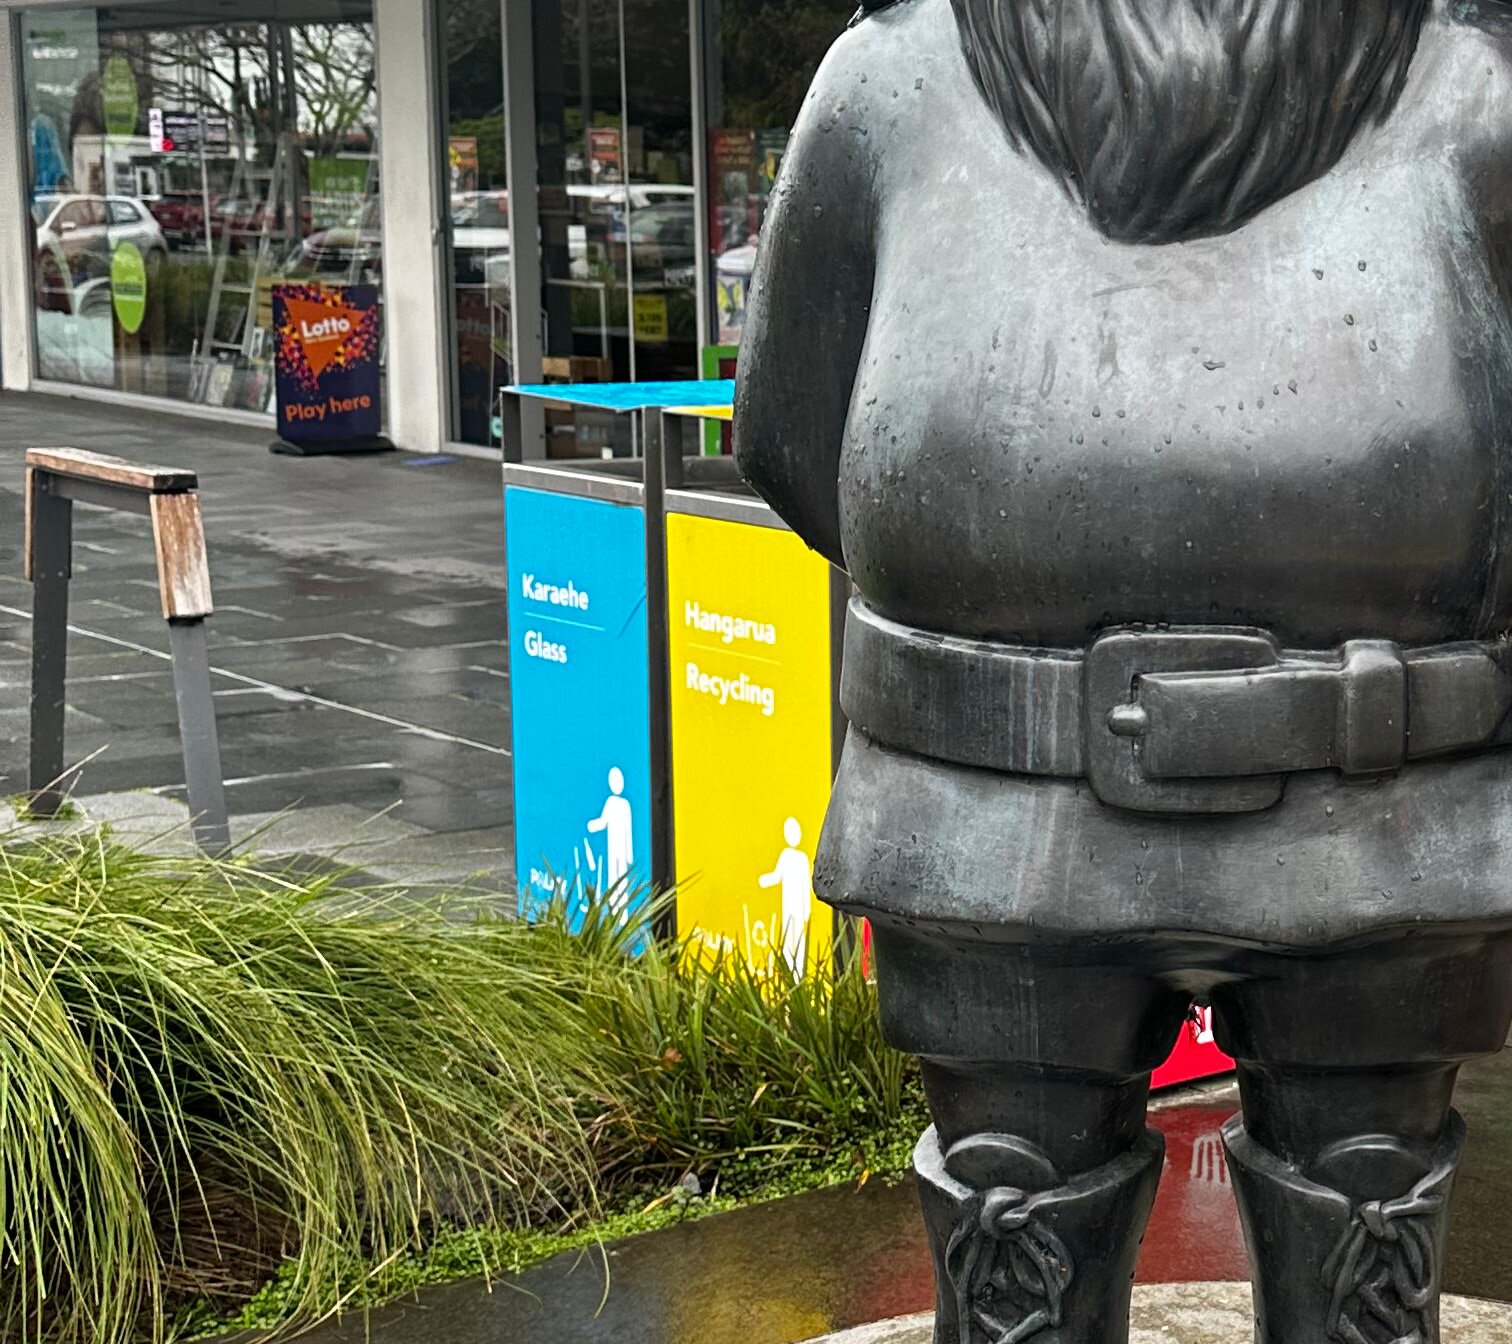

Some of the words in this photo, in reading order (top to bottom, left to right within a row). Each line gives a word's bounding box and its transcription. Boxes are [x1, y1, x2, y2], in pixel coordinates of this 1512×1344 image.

[300, 316, 351, 338] Lotto
[285, 402, 326, 423] Play
[330, 395, 371, 413] here
[522, 573, 589, 610] Karaehe
[685, 600, 776, 644] Hangarua
[524, 630, 567, 663] Glass
[685, 662, 775, 716] Recycling
